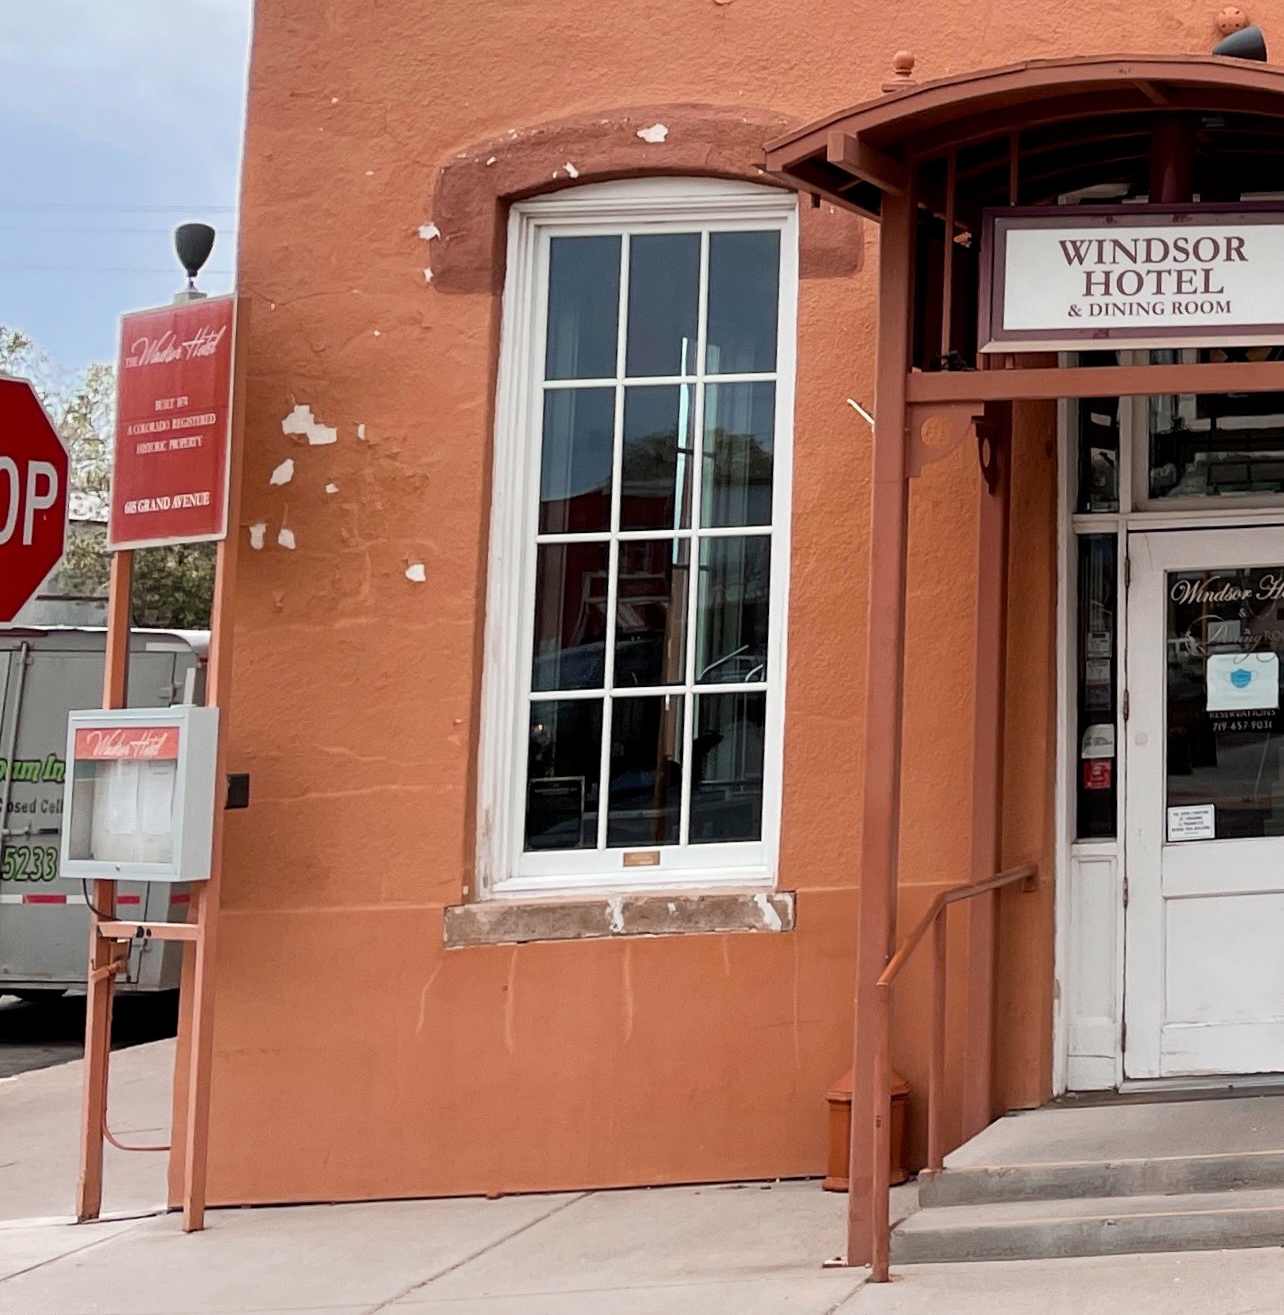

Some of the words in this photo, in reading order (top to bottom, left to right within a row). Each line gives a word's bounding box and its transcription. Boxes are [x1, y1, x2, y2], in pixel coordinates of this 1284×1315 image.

[1059, 236, 1248, 266] WINDSOR
[1082, 268, 1224, 297] HOTEL
[1067, 304, 1082, 318] &
[1089, 301, 1165, 317] DINING
[1172, 300, 1231, 315] ROOM
[138, 496, 170, 513] GRAND
[172, 491, 210, 509] AVENUE
[1170, 576, 1252, 605] Windsor
[1, 845, 58, 882] 5233
